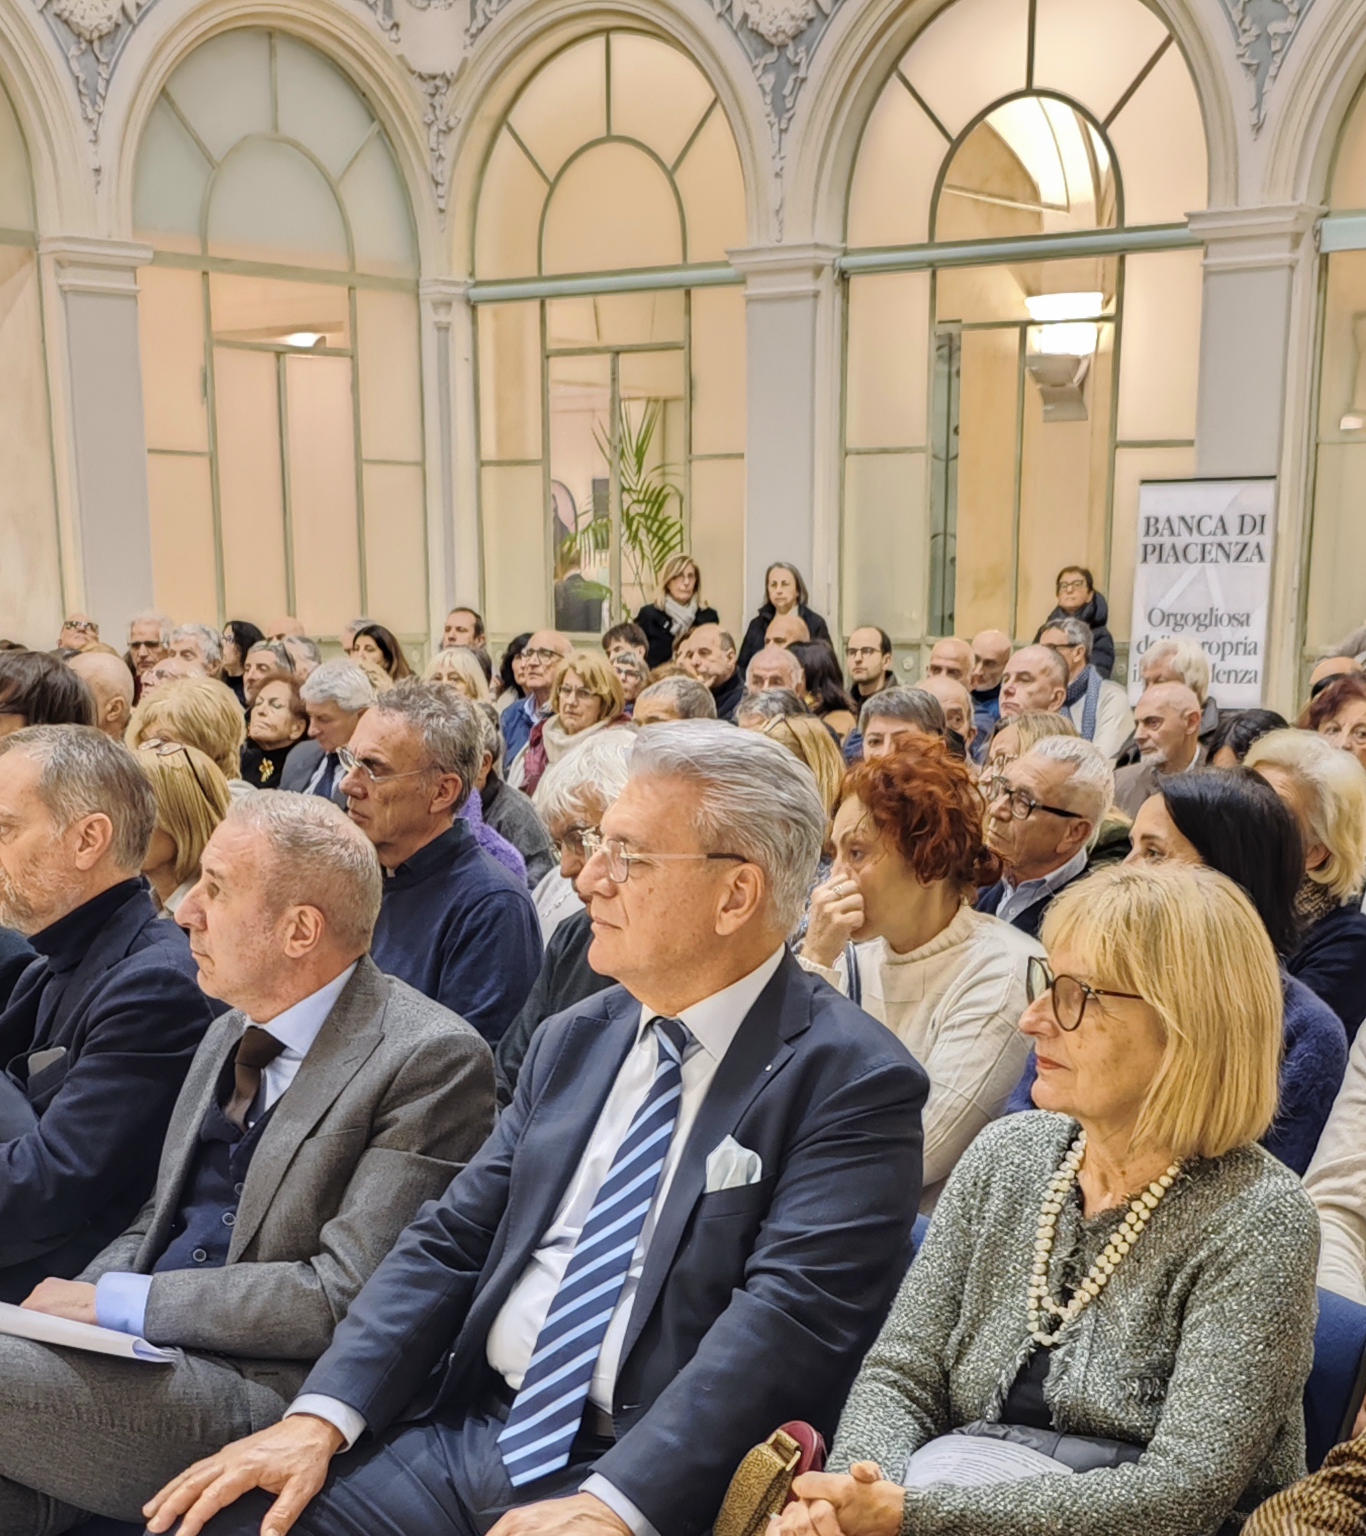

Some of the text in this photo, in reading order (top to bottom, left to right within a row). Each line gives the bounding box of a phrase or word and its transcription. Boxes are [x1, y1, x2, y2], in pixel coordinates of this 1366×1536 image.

[1143, 514, 1267, 538] BANCA DI
[1140, 541, 1266, 564] PIACENZA
[1147, 606, 1252, 633] Orgogliosa
[1200, 635, 1259, 662] ropria
